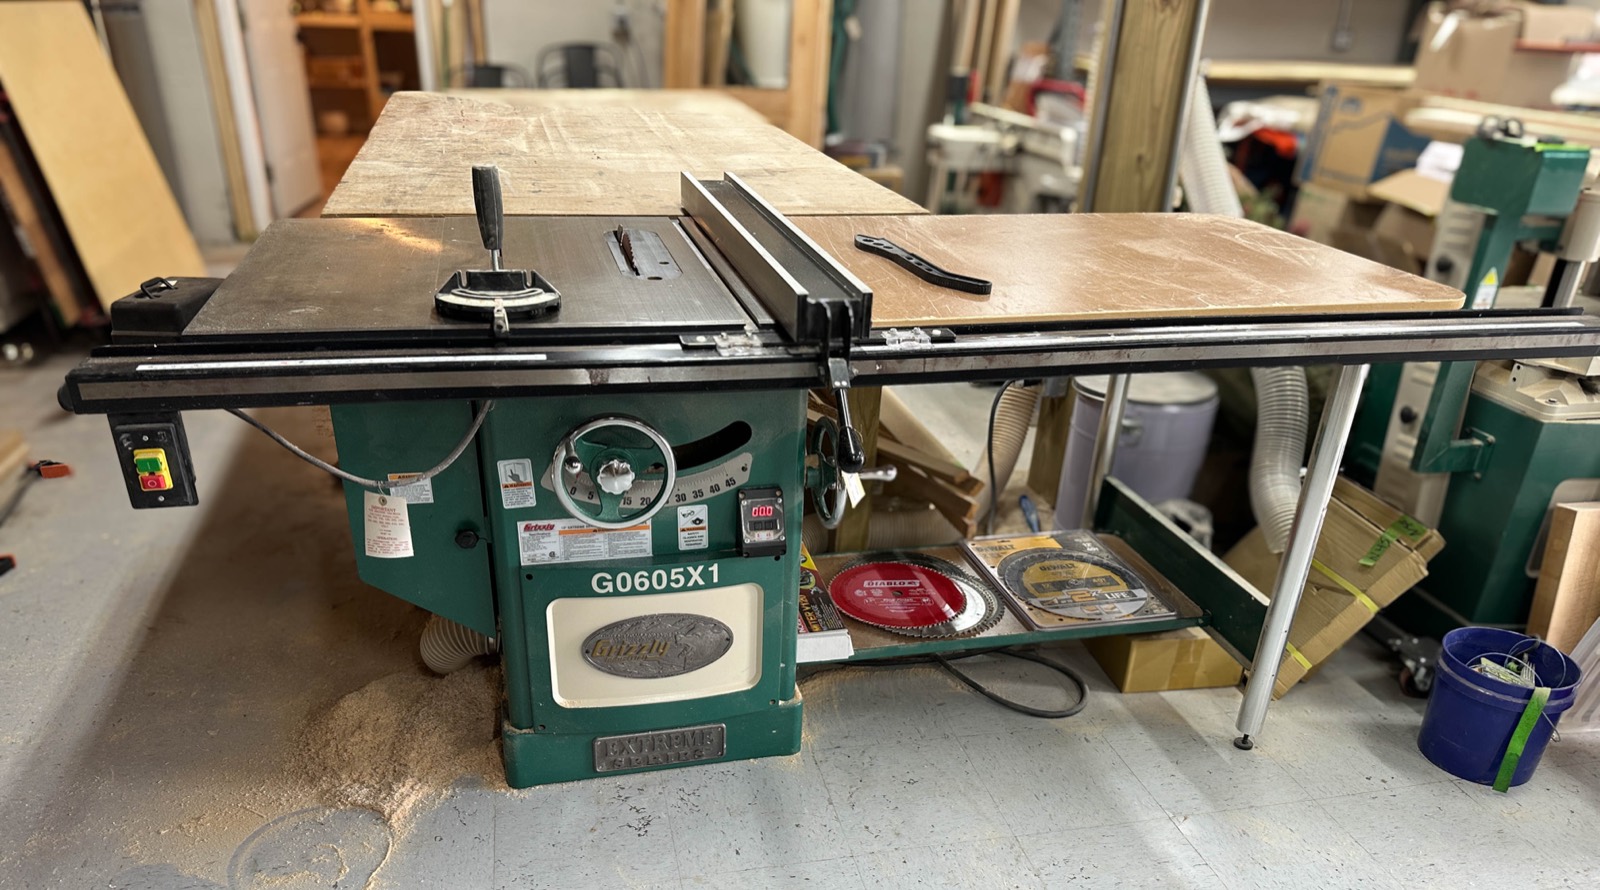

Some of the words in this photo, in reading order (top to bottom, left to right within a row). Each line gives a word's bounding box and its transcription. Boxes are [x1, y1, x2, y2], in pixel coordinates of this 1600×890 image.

[570, 487, 577, 496] 0
[587, 492, 594, 500] 5
[640, 497, 651, 506] 20
[675, 493, 687, 503] 30
[692, 488, 704, 499] 35
[709, 483, 721, 494] 40
[725, 477, 737, 488] 45
[524, 523, 555, 532] Grizzly
[591, 563, 719, 594] G0605X1
[1104, 592, 1130, 600] LIFE
[591, 638, 671, 658] Grizzly
[604, 730, 715, 757] EXTREME
[612, 748, 705, 767] SERIES
